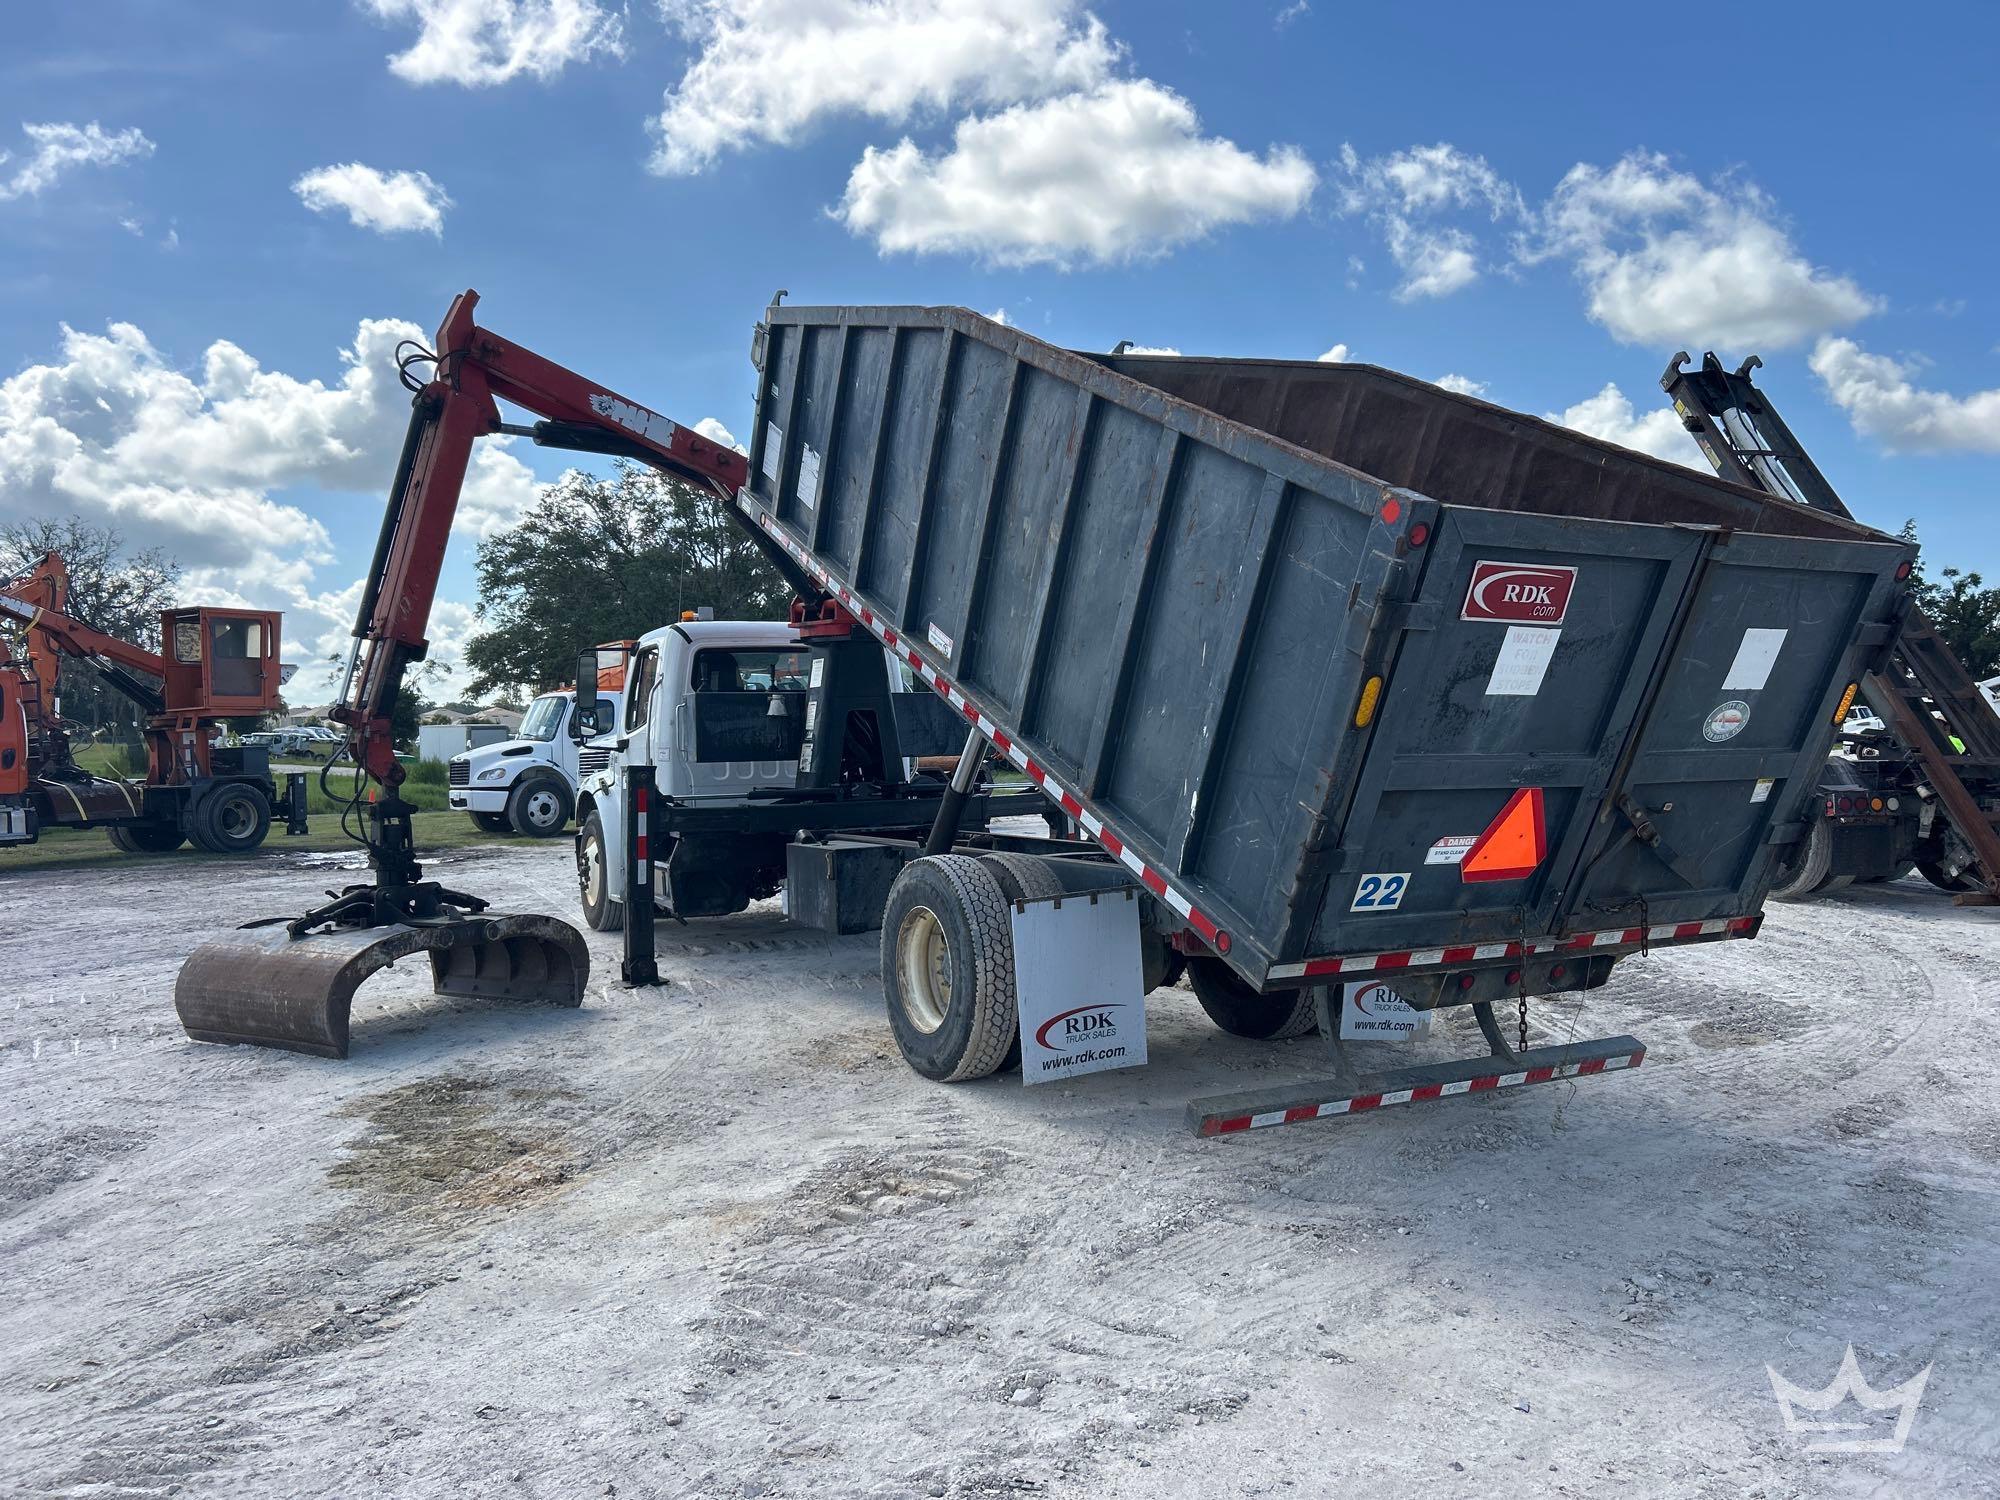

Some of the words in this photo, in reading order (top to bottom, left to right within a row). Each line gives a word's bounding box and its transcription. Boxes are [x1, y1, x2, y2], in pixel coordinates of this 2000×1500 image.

[1502, 584, 1555, 604] RDK
[1529, 605, 1556, 617] .com
[1511, 632, 1552, 645] WATCH
[1354, 876, 1405, 907] 22
[1375, 1003, 1392, 1012] TRUCK
[1393, 1004, 1411, 1013] SALES
[1065, 1011, 1115, 1034] RDK
[1354, 1020, 1414, 1031] www.rdk.com
[1066, 1032, 1090, 1044] TRUCK
[1092, 1027, 1117, 1039] SALES
[1042, 1046, 1125, 1071] www.rdk.com
